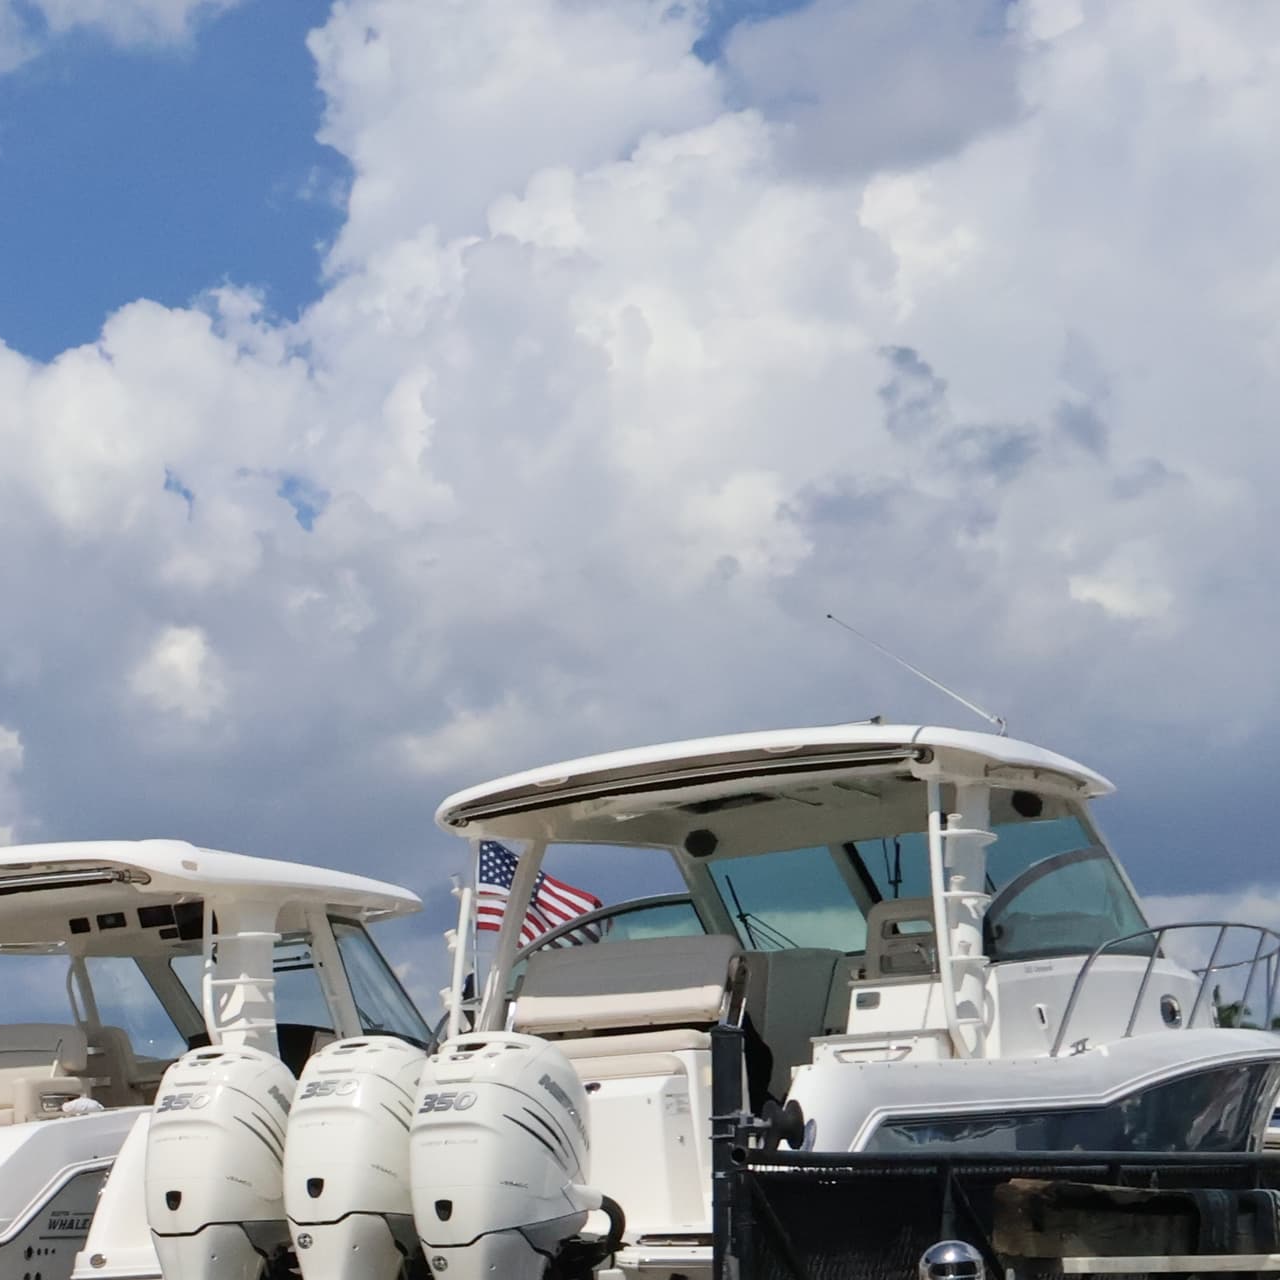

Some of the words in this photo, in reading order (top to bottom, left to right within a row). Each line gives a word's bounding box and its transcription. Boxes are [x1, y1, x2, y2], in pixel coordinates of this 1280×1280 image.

[299, 1079, 360, 1101] 350
[156, 1092, 211, 1114] 350
[418, 1091, 478, 1114] 350
[48, 1218, 91, 1230] WHALE
